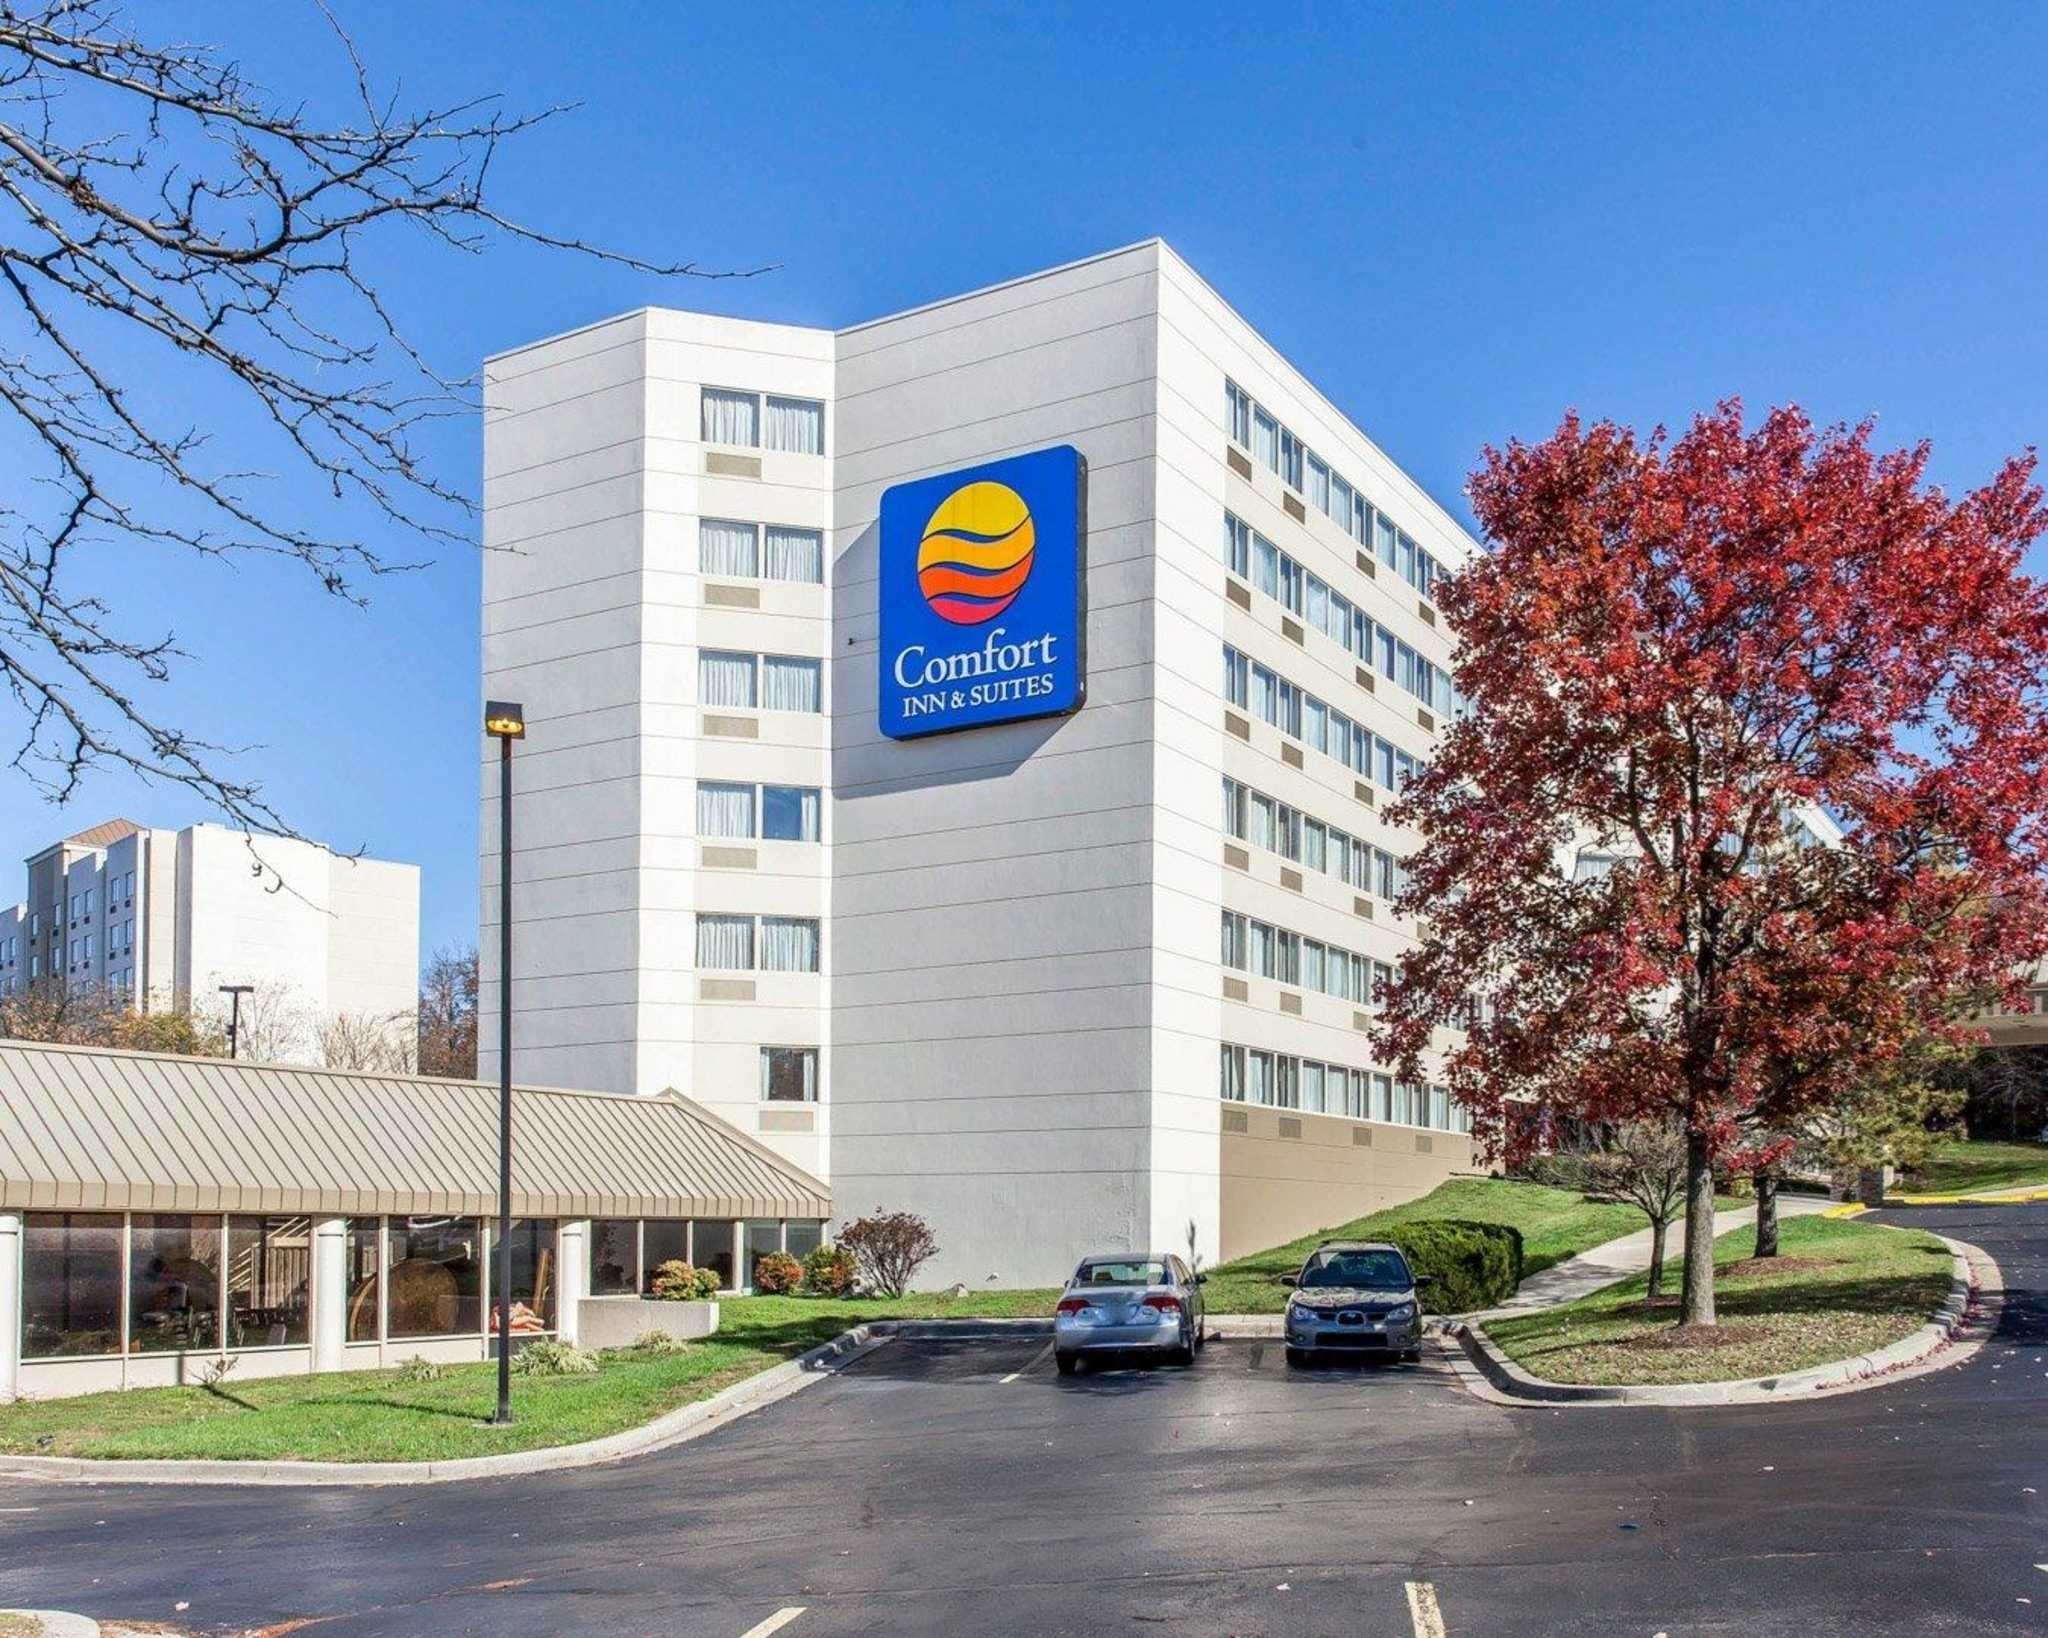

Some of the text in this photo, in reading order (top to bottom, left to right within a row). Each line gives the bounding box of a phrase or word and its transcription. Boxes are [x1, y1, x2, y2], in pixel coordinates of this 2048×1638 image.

[894, 628, 1058, 688] Comfort
[902, 673, 1054, 718] INN & SUITES
